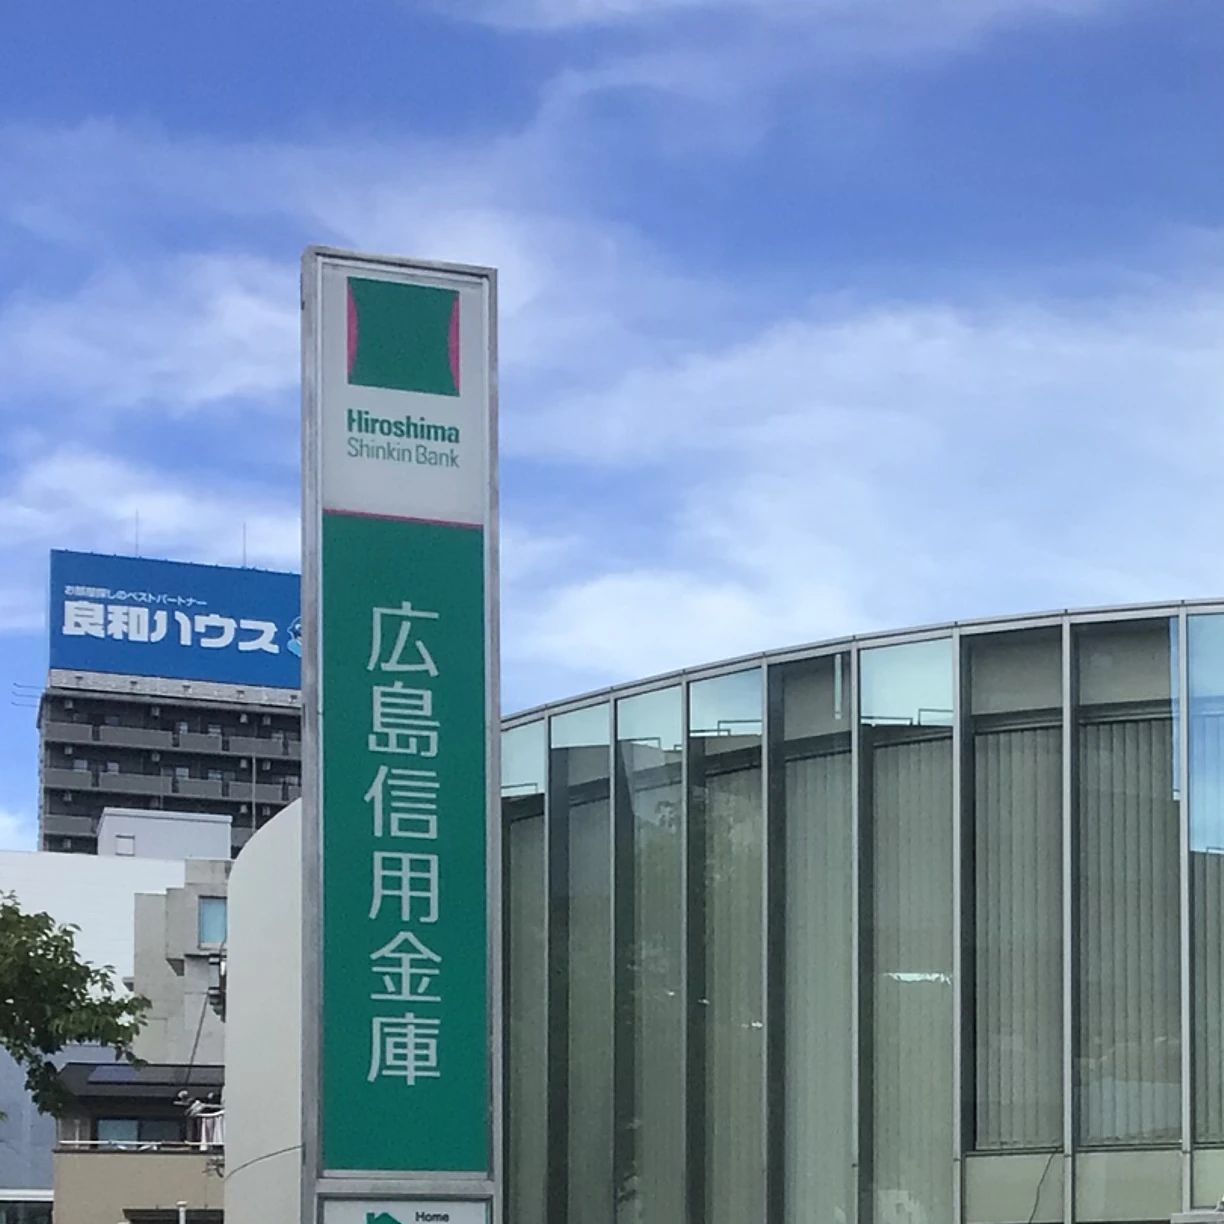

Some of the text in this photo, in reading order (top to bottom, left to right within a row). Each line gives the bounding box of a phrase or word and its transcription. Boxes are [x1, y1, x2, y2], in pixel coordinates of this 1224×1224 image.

[347, 408, 460, 443] Hiroshima
[347, 437, 461, 468] Shinkin Bank
[62, 600, 280, 654] 良和ハウス
[364, 601, 442, 1087] 広島信用金庫
[415, 1212, 450, 1222] Home
